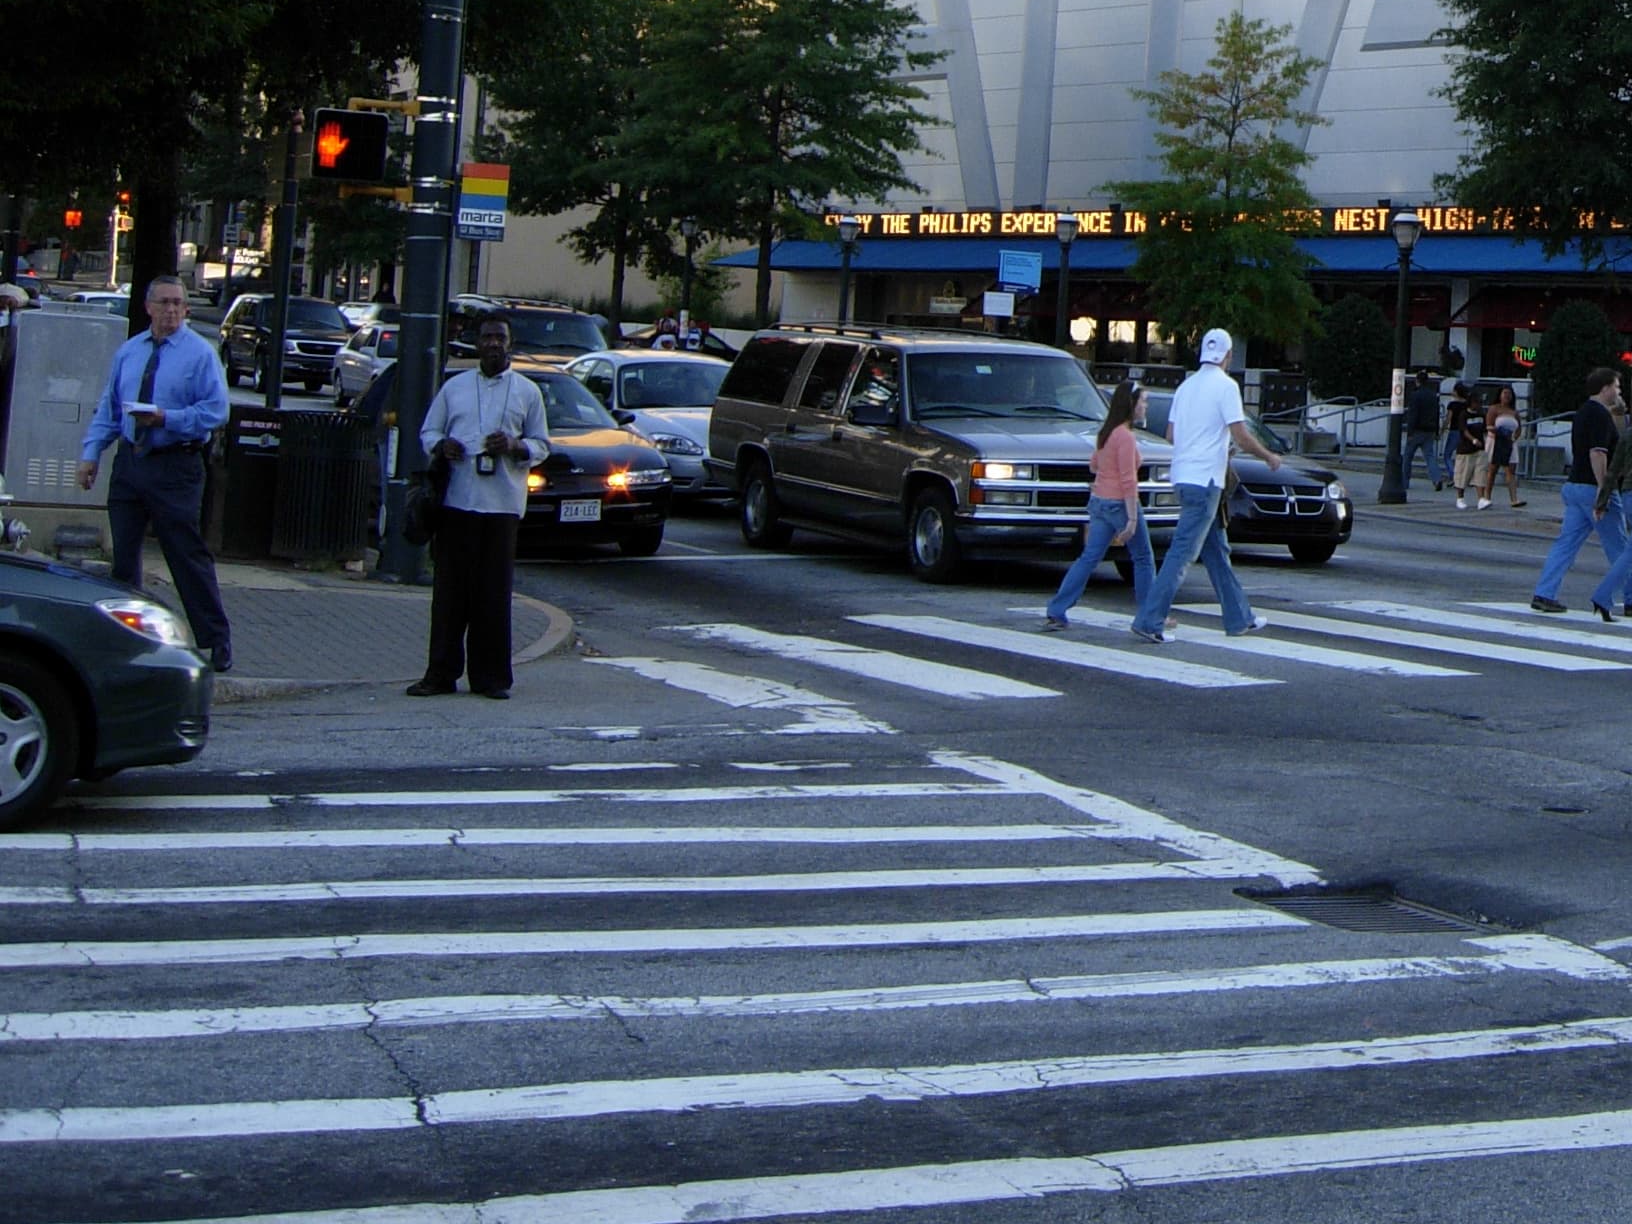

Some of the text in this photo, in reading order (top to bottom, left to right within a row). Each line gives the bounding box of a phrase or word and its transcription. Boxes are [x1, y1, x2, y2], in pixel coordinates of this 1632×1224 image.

[461, 212, 503, 224] marta
[881, 214, 910, 234] THE
[919, 213, 992, 234] PHILIPS
[1001, 212, 1112, 233] EXPERNCE
[1334, 208, 1389, 231] NEST
